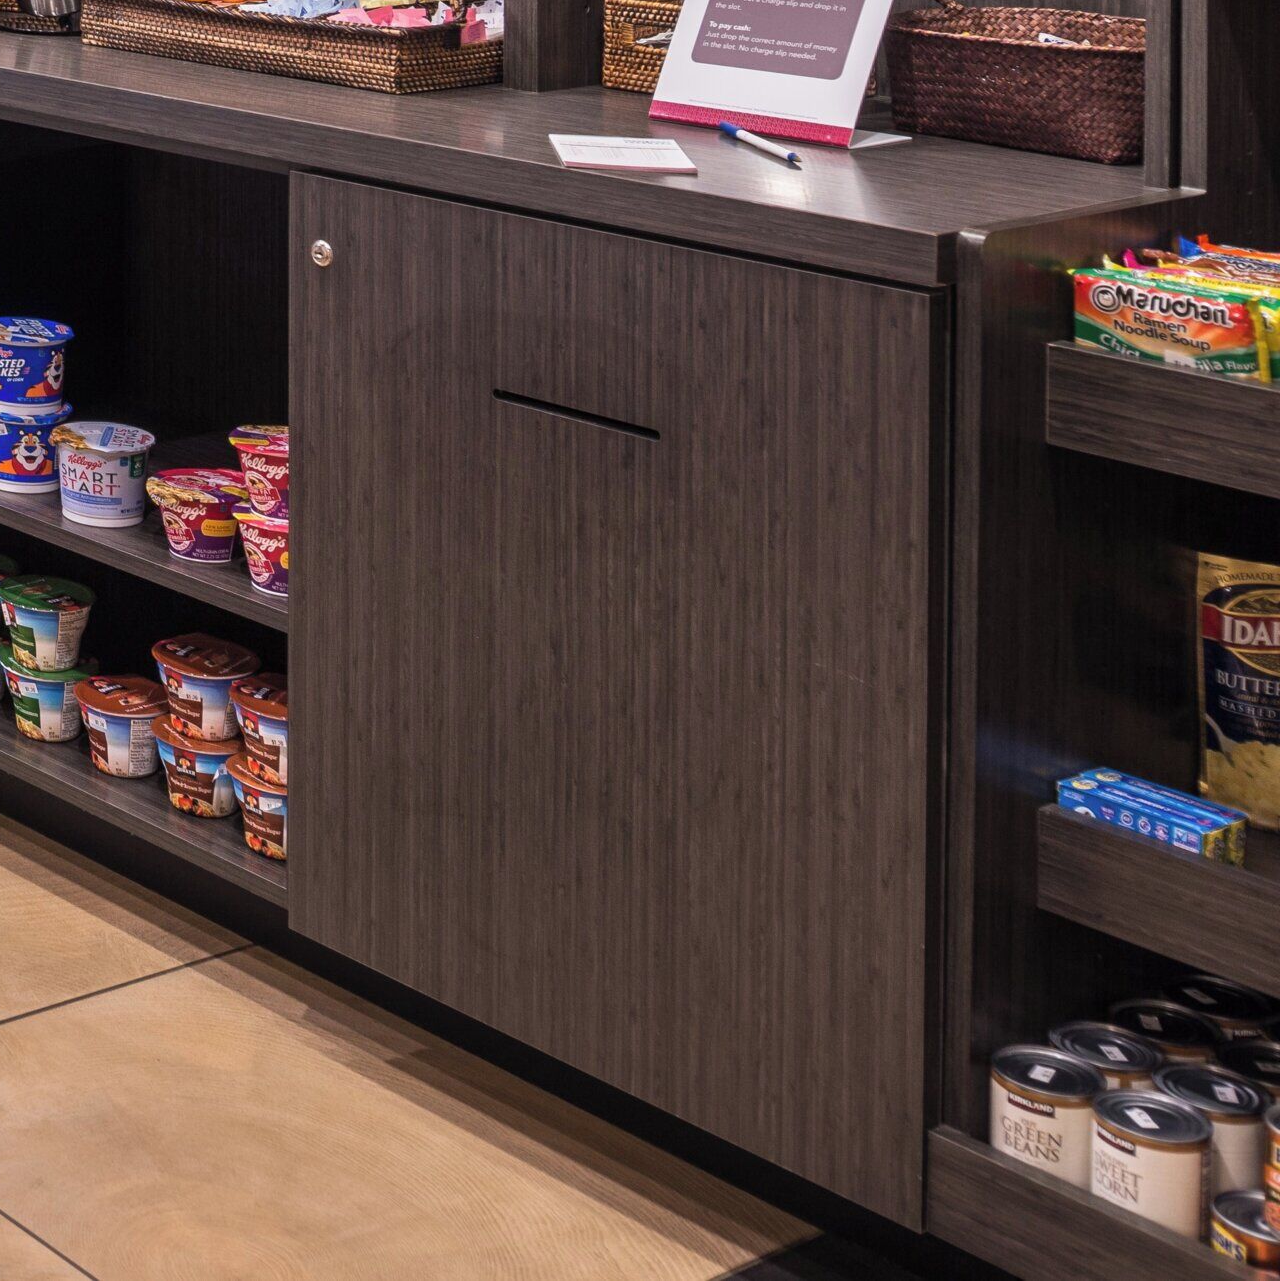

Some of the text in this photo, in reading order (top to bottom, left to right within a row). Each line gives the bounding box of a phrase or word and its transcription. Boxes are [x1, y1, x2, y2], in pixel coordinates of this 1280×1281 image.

[786, 0, 798, 7] slip
[815, 3, 831, 11] drop
[721, 32, 737, 40] drop
[751, 37, 775, 45] correct
[776, 40, 802, 48] amount
[813, 44, 837, 53] money
[751, 47, 773, 55] charge
[775, 49, 787, 57] slip
[789, 50, 817, 60] needed.
[1117, 285, 1232, 328] Maruchan
[1133, 313, 1188, 334] Ramen
[1113, 320, 1212, 352] Noodle Soup
[61, 463, 118, 484] SMART
[67, 453, 105, 471] Kellogg's
[61, 476, 119, 496] START
[240, 523, 287, 552] Kellogg's
[1217, 571, 1276, 584] HOMEMADE
[1008, 1092, 1056, 1116] KIRKLAND
[1001, 1116, 1064, 1149] GREEN
[1098, 1126, 1136, 1153] KIRKLAND
[1004, 1131, 1061, 1164] BEANS
[1094, 1150, 1143, 1186] SWEET
[1095, 1166, 1139, 1204] CORN
